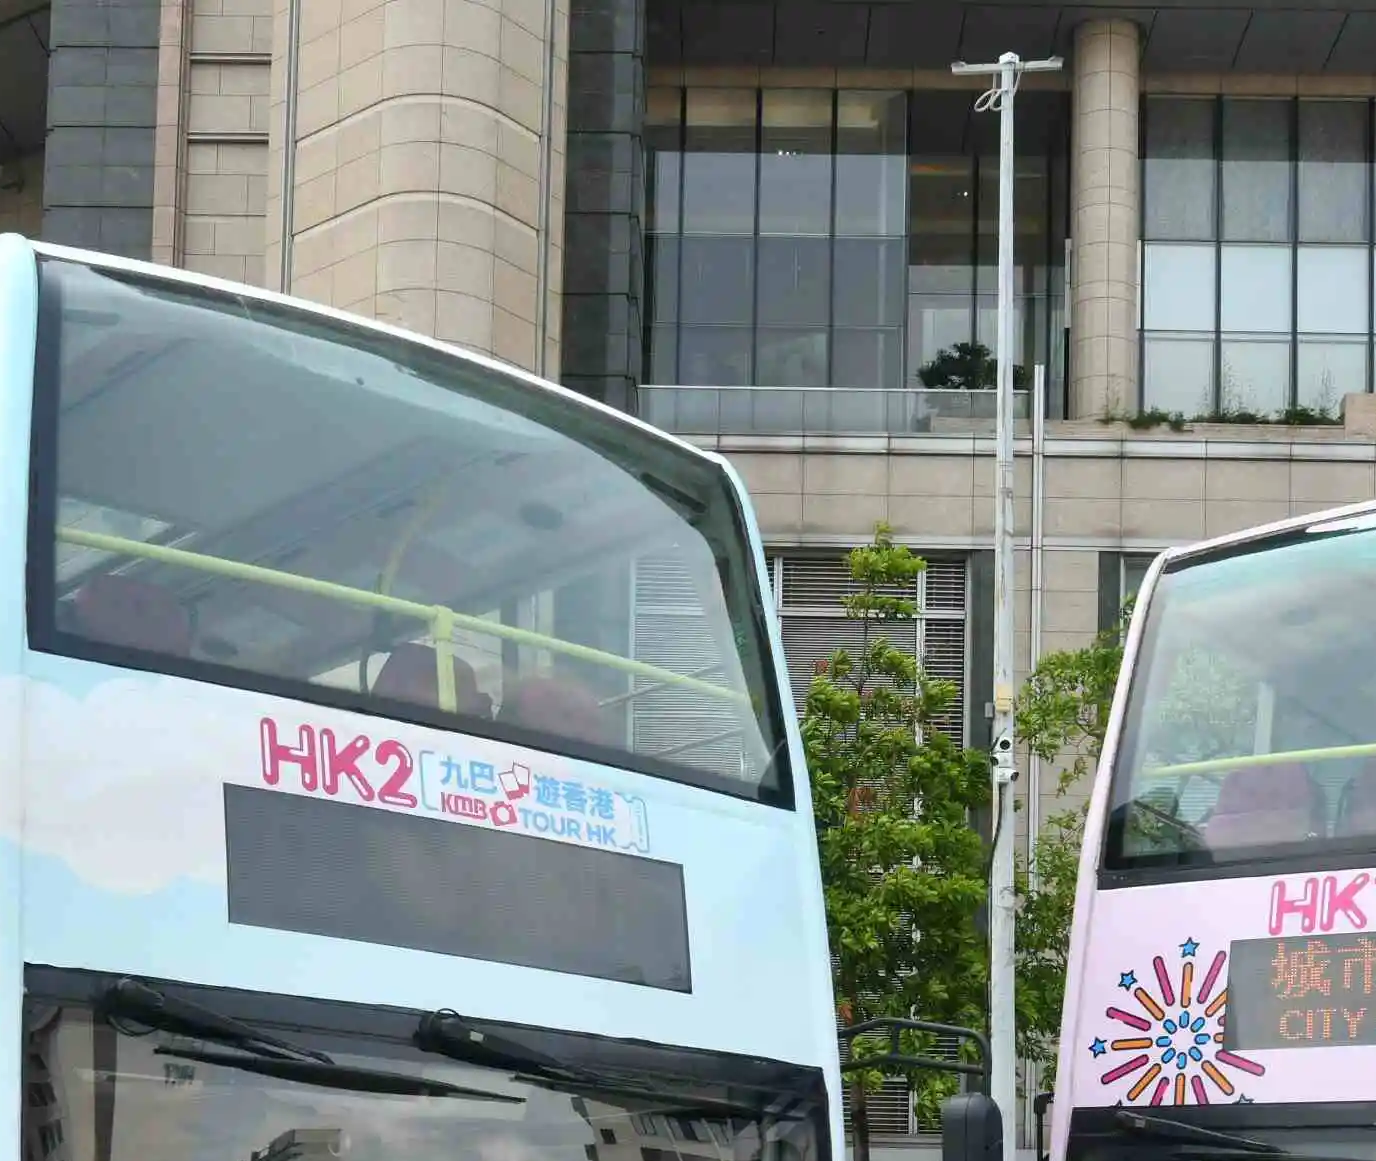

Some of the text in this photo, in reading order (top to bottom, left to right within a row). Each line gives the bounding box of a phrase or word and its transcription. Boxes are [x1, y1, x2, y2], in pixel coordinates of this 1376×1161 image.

[260, 716, 417, 809] HK2
[439, 755, 616, 822] 九巴 遊香港
[440, 791, 618, 848] KMB TOUR HK
[1278, 1005, 1368, 1040] CITY
